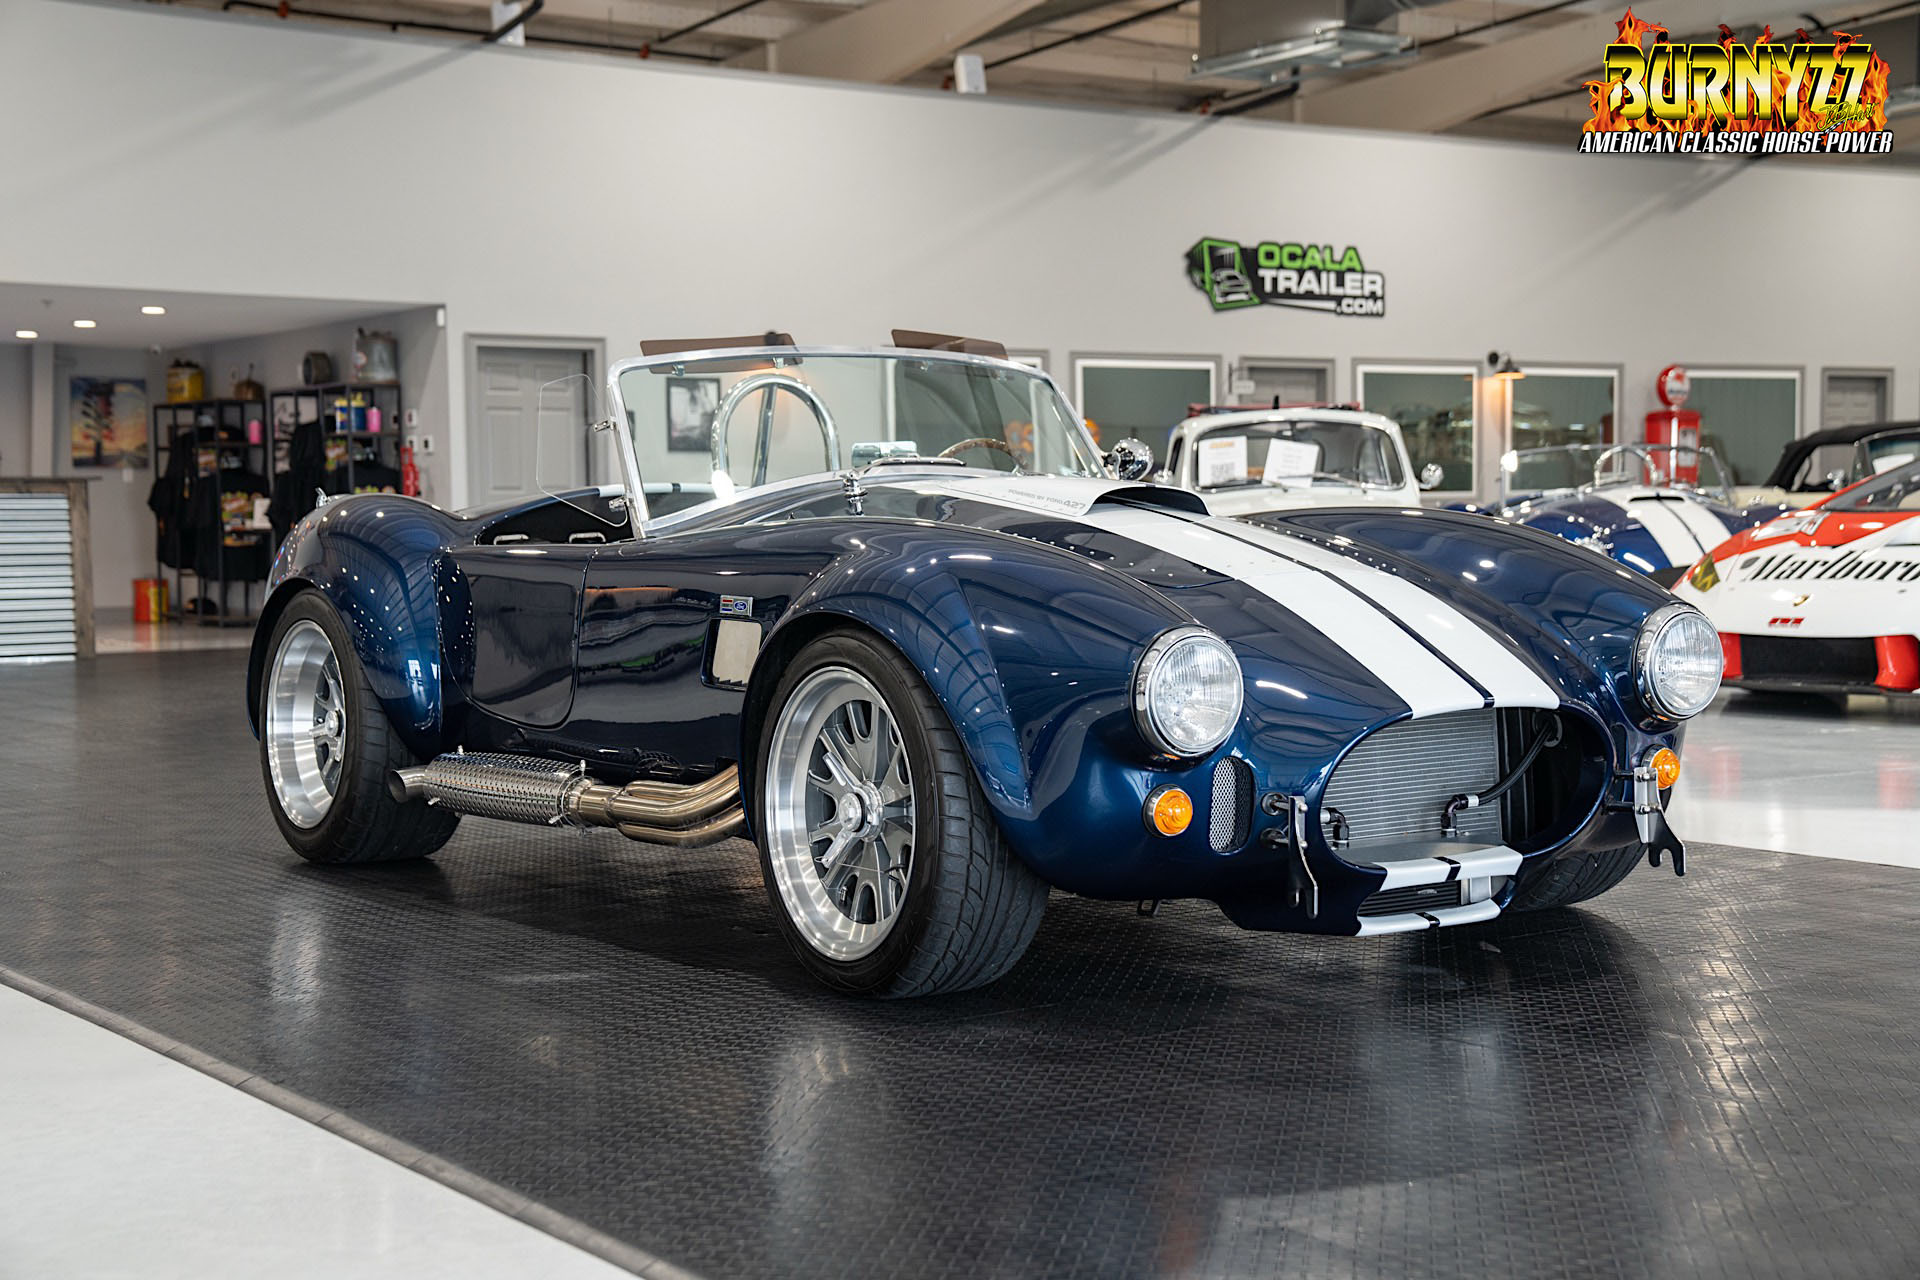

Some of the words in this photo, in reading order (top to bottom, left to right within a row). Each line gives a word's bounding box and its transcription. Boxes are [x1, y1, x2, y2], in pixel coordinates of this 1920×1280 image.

[1257, 243, 1363, 271] OCALA
[1257, 268, 1384, 297] TRAILER
[1336, 297, 1383, 315] .COM
[1064, 500, 1086, 509] 427
[1742, 550, 1920, 581] Marlboro
